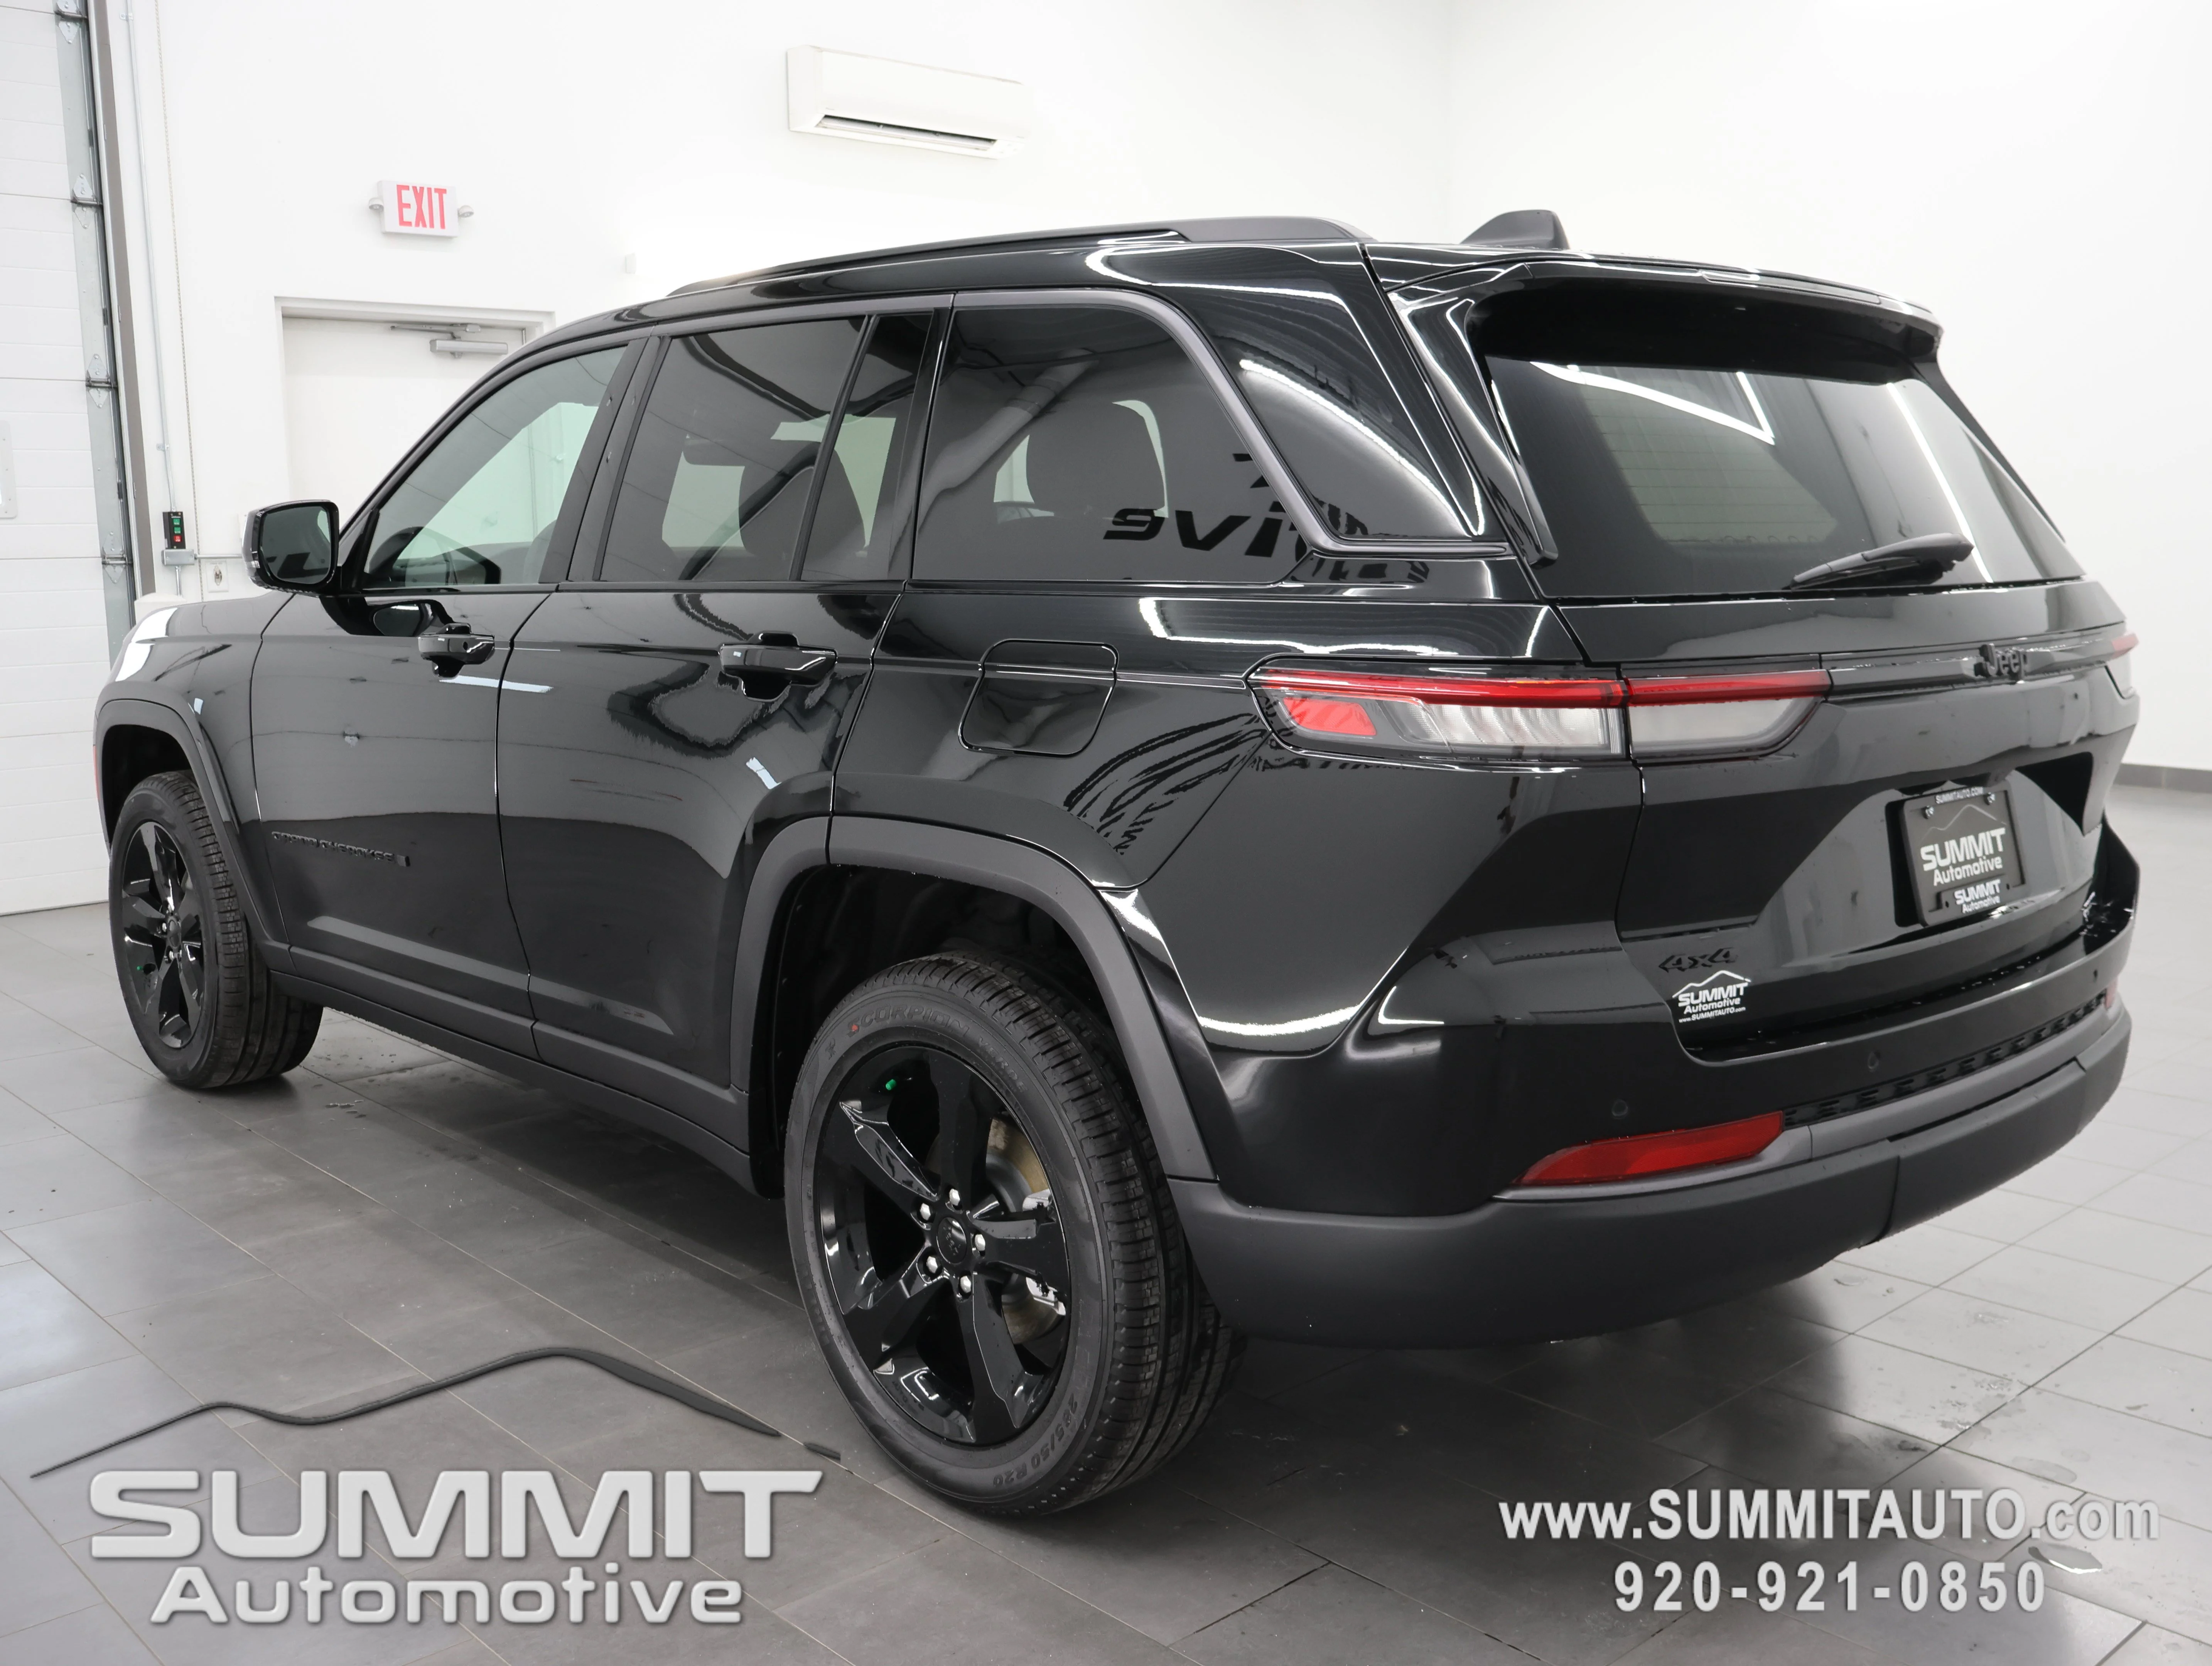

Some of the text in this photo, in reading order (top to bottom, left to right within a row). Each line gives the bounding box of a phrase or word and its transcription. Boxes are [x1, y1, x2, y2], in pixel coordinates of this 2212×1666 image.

[397, 184, 447, 229] EXIT
[1974, 643, 2030, 680] Jeep
[1920, 827, 2006, 871] SUMMIT
[1934, 856, 2003, 887] Automotive
[1954, 879, 2001, 905] SUMMIT
[1962, 896, 2001, 914] Automotive
[1678, 982, 1749, 1007] SUMMIT
[1684, 997, 1740, 1014] Automotive
[847, 1004, 971, 1037] SCORPION
[1679, 1007, 1746, 1023] www.SUMMITAUTO.com
